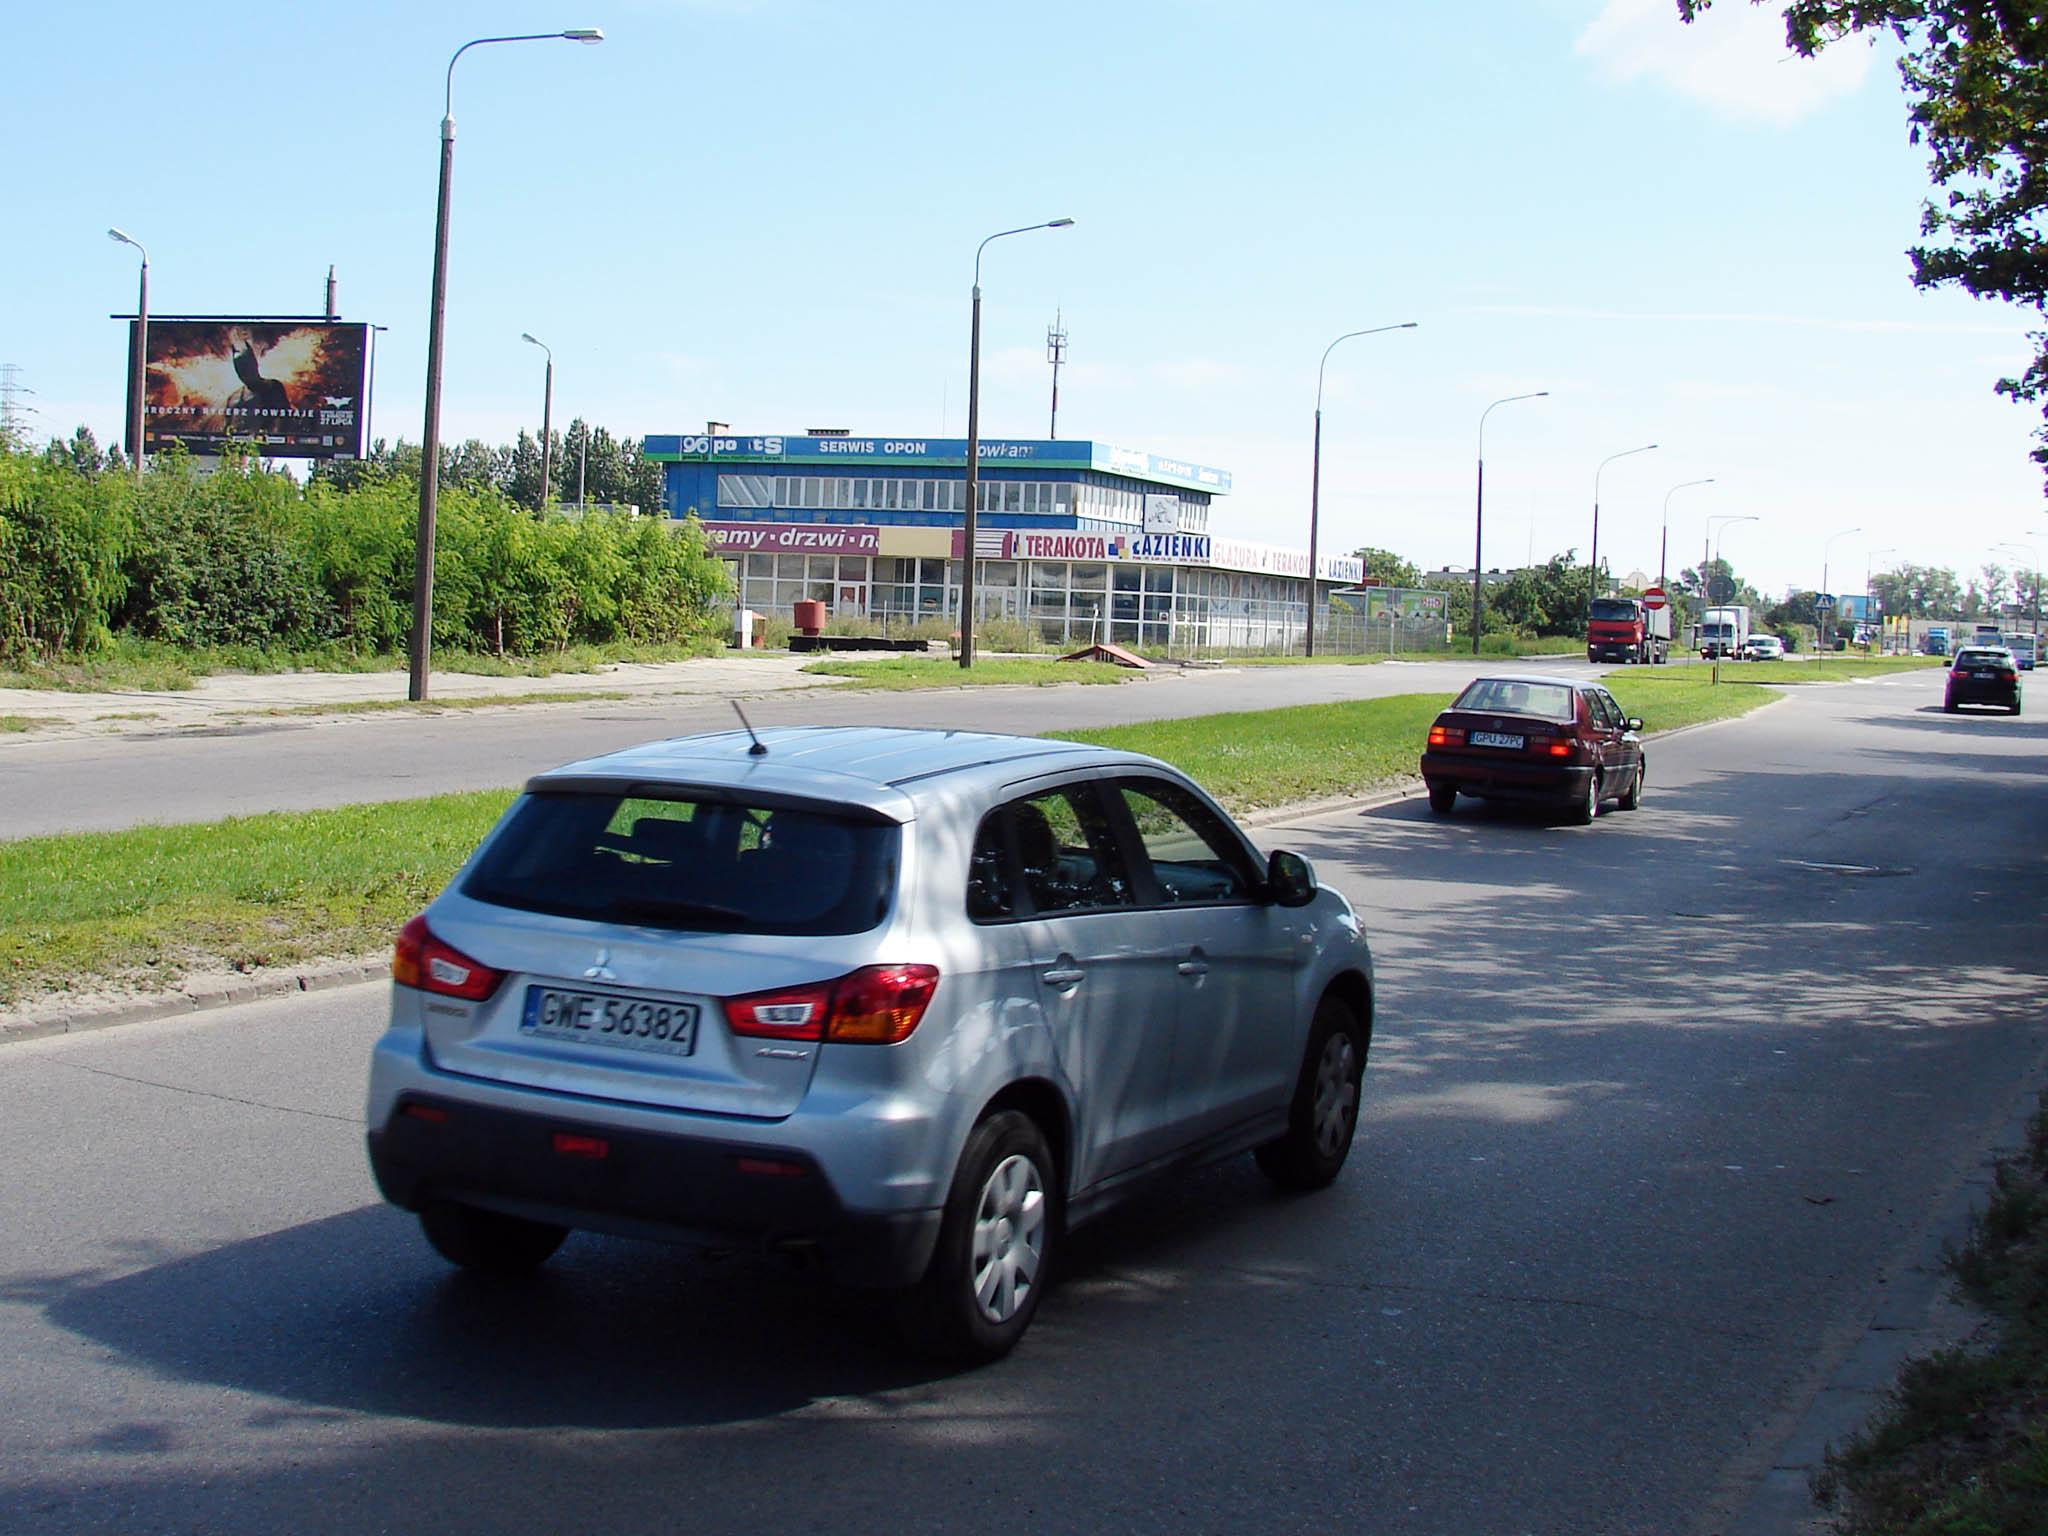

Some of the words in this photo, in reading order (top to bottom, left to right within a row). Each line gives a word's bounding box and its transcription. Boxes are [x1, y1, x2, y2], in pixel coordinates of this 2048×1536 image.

[254, 408, 314, 418] POWSTAJE
[819, 441, 874, 453] SERWIS
[884, 442, 926, 454] OPON
[779, 528, 847, 548] drzwi
[1026, 535, 1106, 559] TERAKOTA
[1214, 542, 1258, 570] GLAZURA
[1475, 733, 1497, 744] GPU
[541, 993, 594, 1030] GWE
[601, 1001, 689, 1042] 56382
